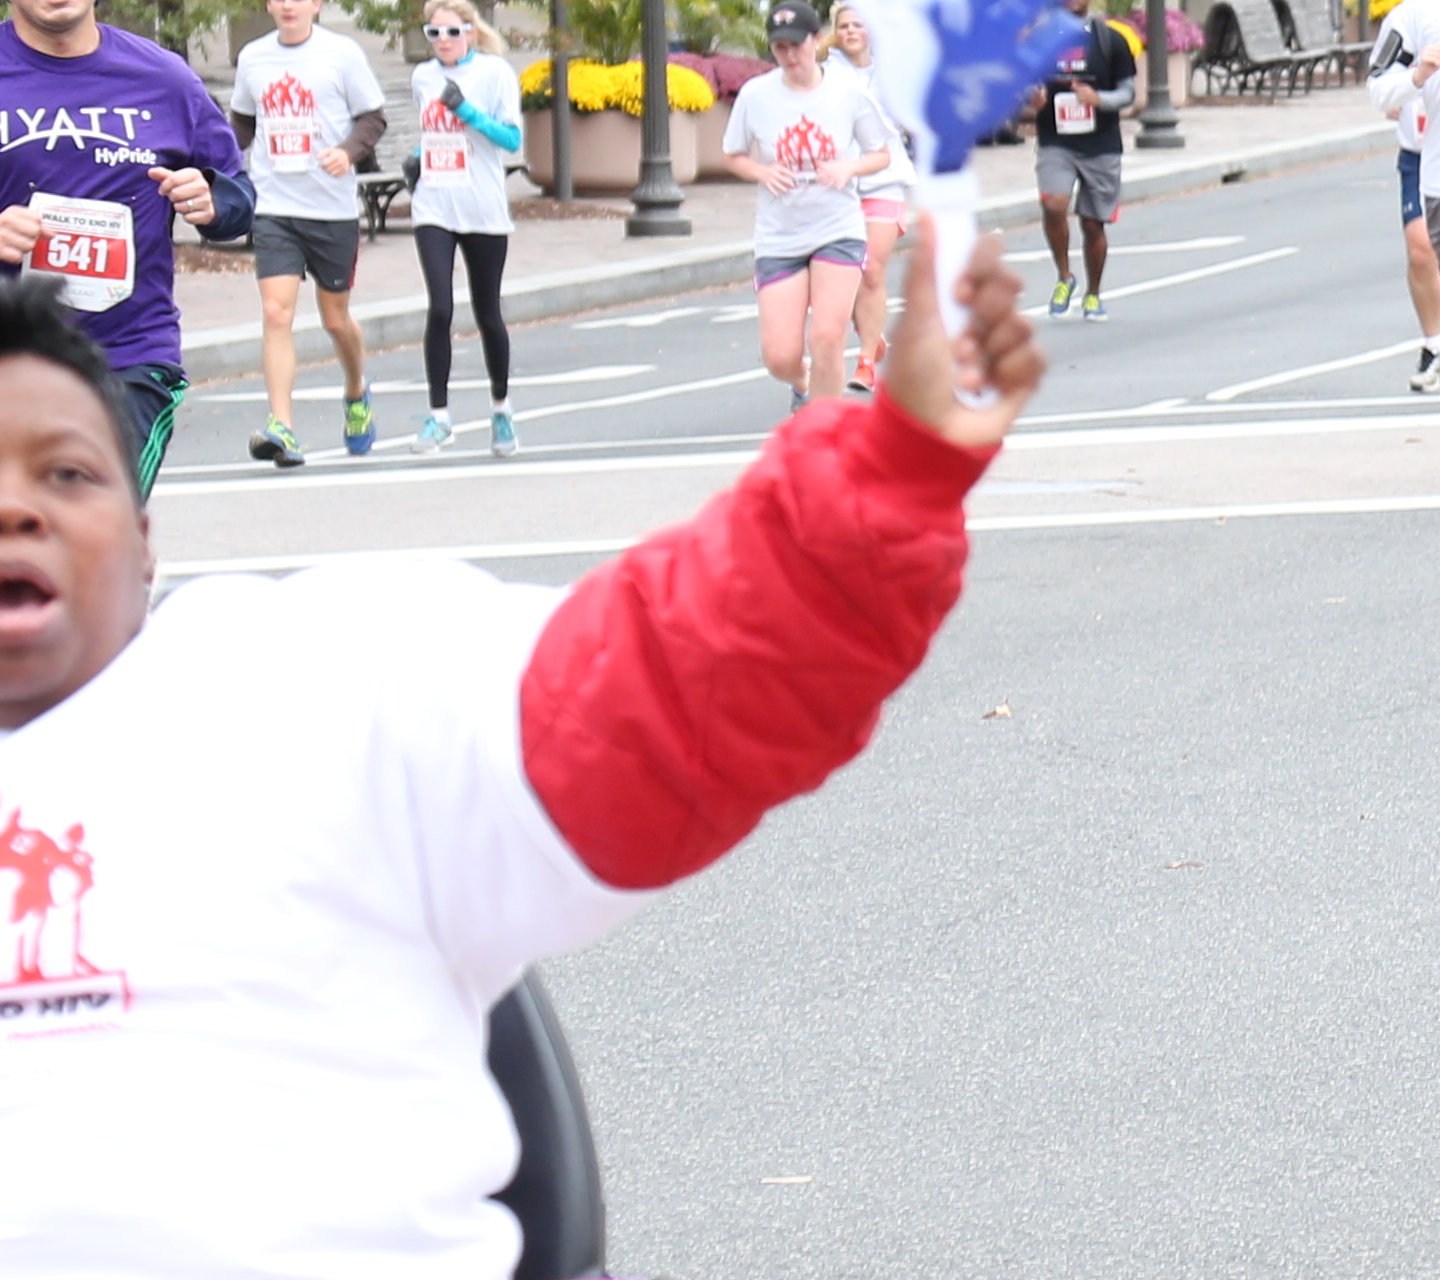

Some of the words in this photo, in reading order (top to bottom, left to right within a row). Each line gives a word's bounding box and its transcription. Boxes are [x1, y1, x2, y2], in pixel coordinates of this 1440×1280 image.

[94, 147, 157, 166] HyPride
[42, 212, 70, 224] WALK
[73, 215, 86, 225] TO
[89, 217, 107, 228] END
[109, 219, 121, 230] HIV
[47, 234, 109, 273] 541
